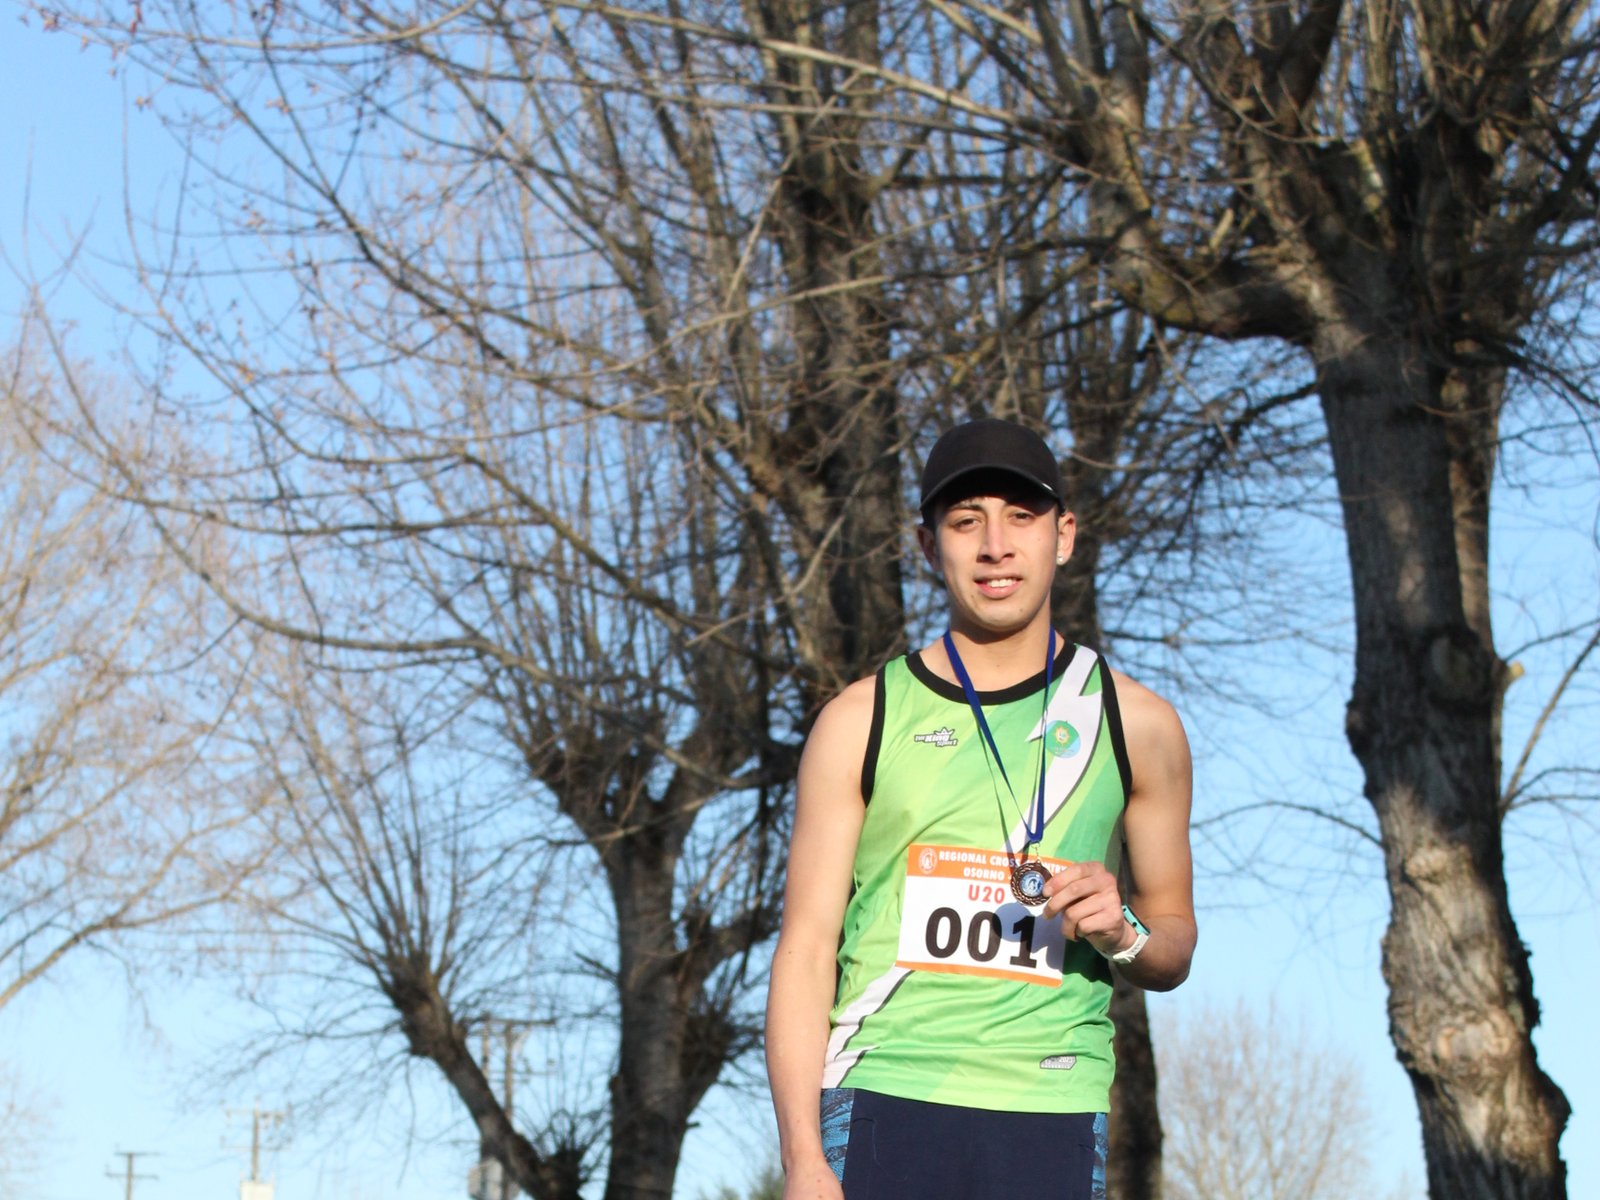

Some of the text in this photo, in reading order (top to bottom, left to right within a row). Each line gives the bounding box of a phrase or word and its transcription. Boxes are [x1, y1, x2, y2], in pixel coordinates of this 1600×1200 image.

[939, 851, 987, 865] REGIONAL
[990, 856, 1021, 868] CROSS
[963, 867, 1005, 880] OSORNO
[968, 884, 1005, 904] U20
[925, 907, 1038, 968] 001
